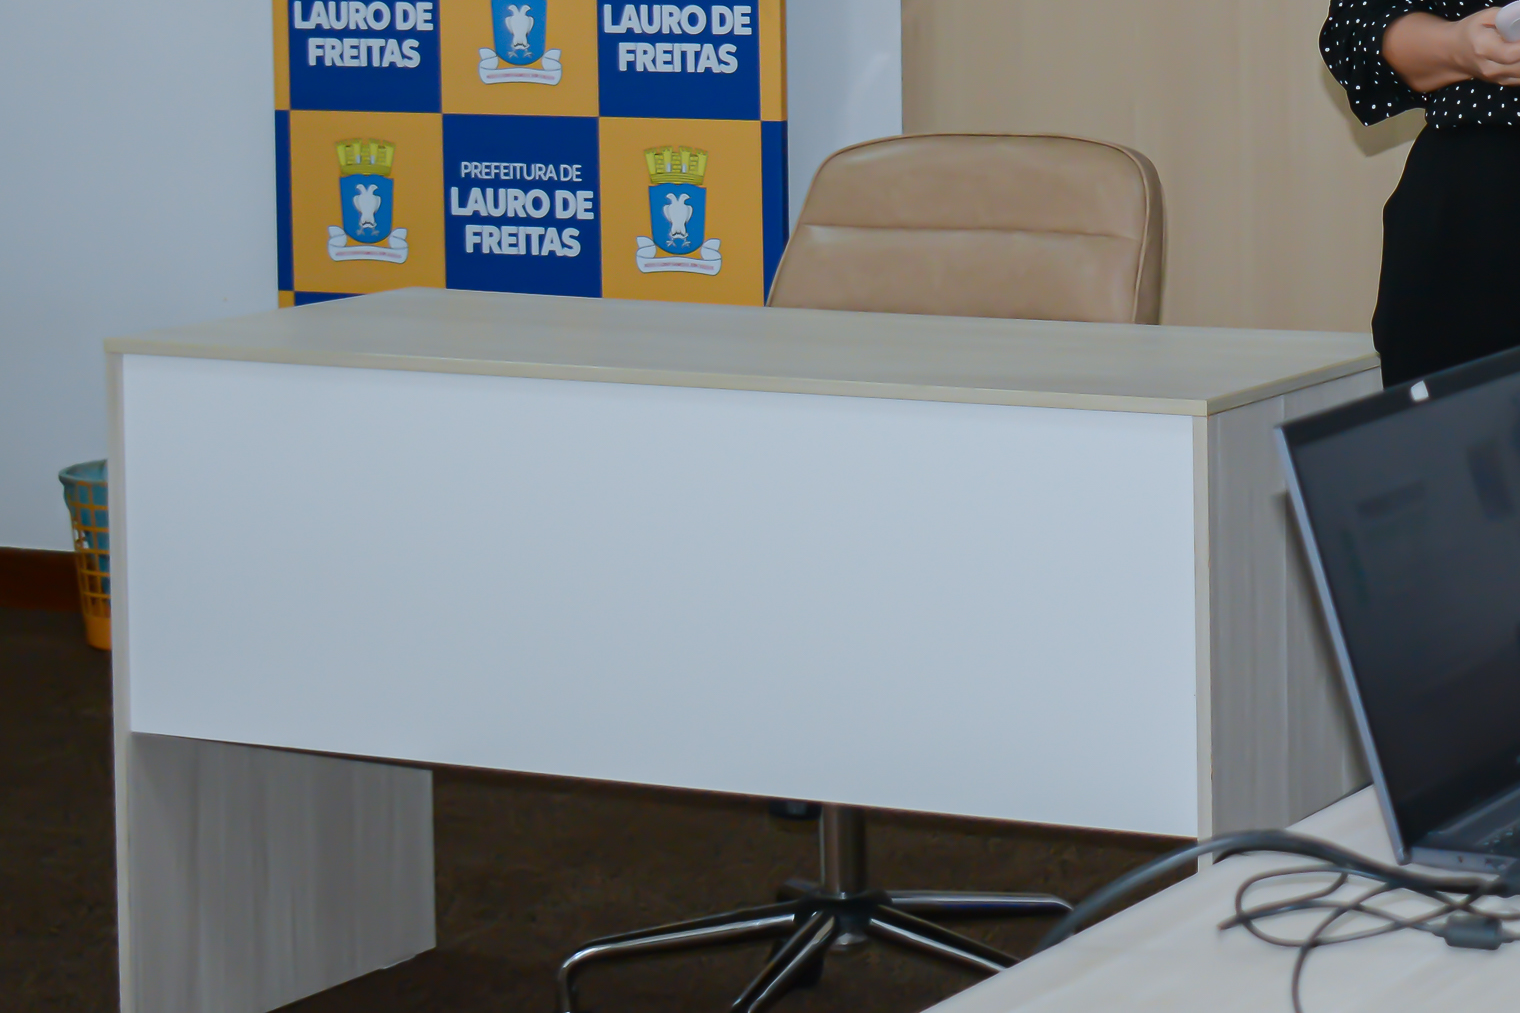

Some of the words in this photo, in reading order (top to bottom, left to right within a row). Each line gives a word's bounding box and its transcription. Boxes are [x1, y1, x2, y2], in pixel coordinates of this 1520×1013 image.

[293, 1, 391, 31] LAURO
[394, 2, 434, 31] DE
[603, 4, 707, 35] LAURO
[711, 6, 753, 36] DE
[307, 38, 421, 69] FREITAS
[618, 43, 738, 74] FREITAS
[460, 162, 558, 181] PREFEITURA
[559, 165, 583, 182] DE
[450, 187, 551, 219] LAURO
[554, 190, 595, 220] DE
[465, 225, 581, 258] FREITAS
